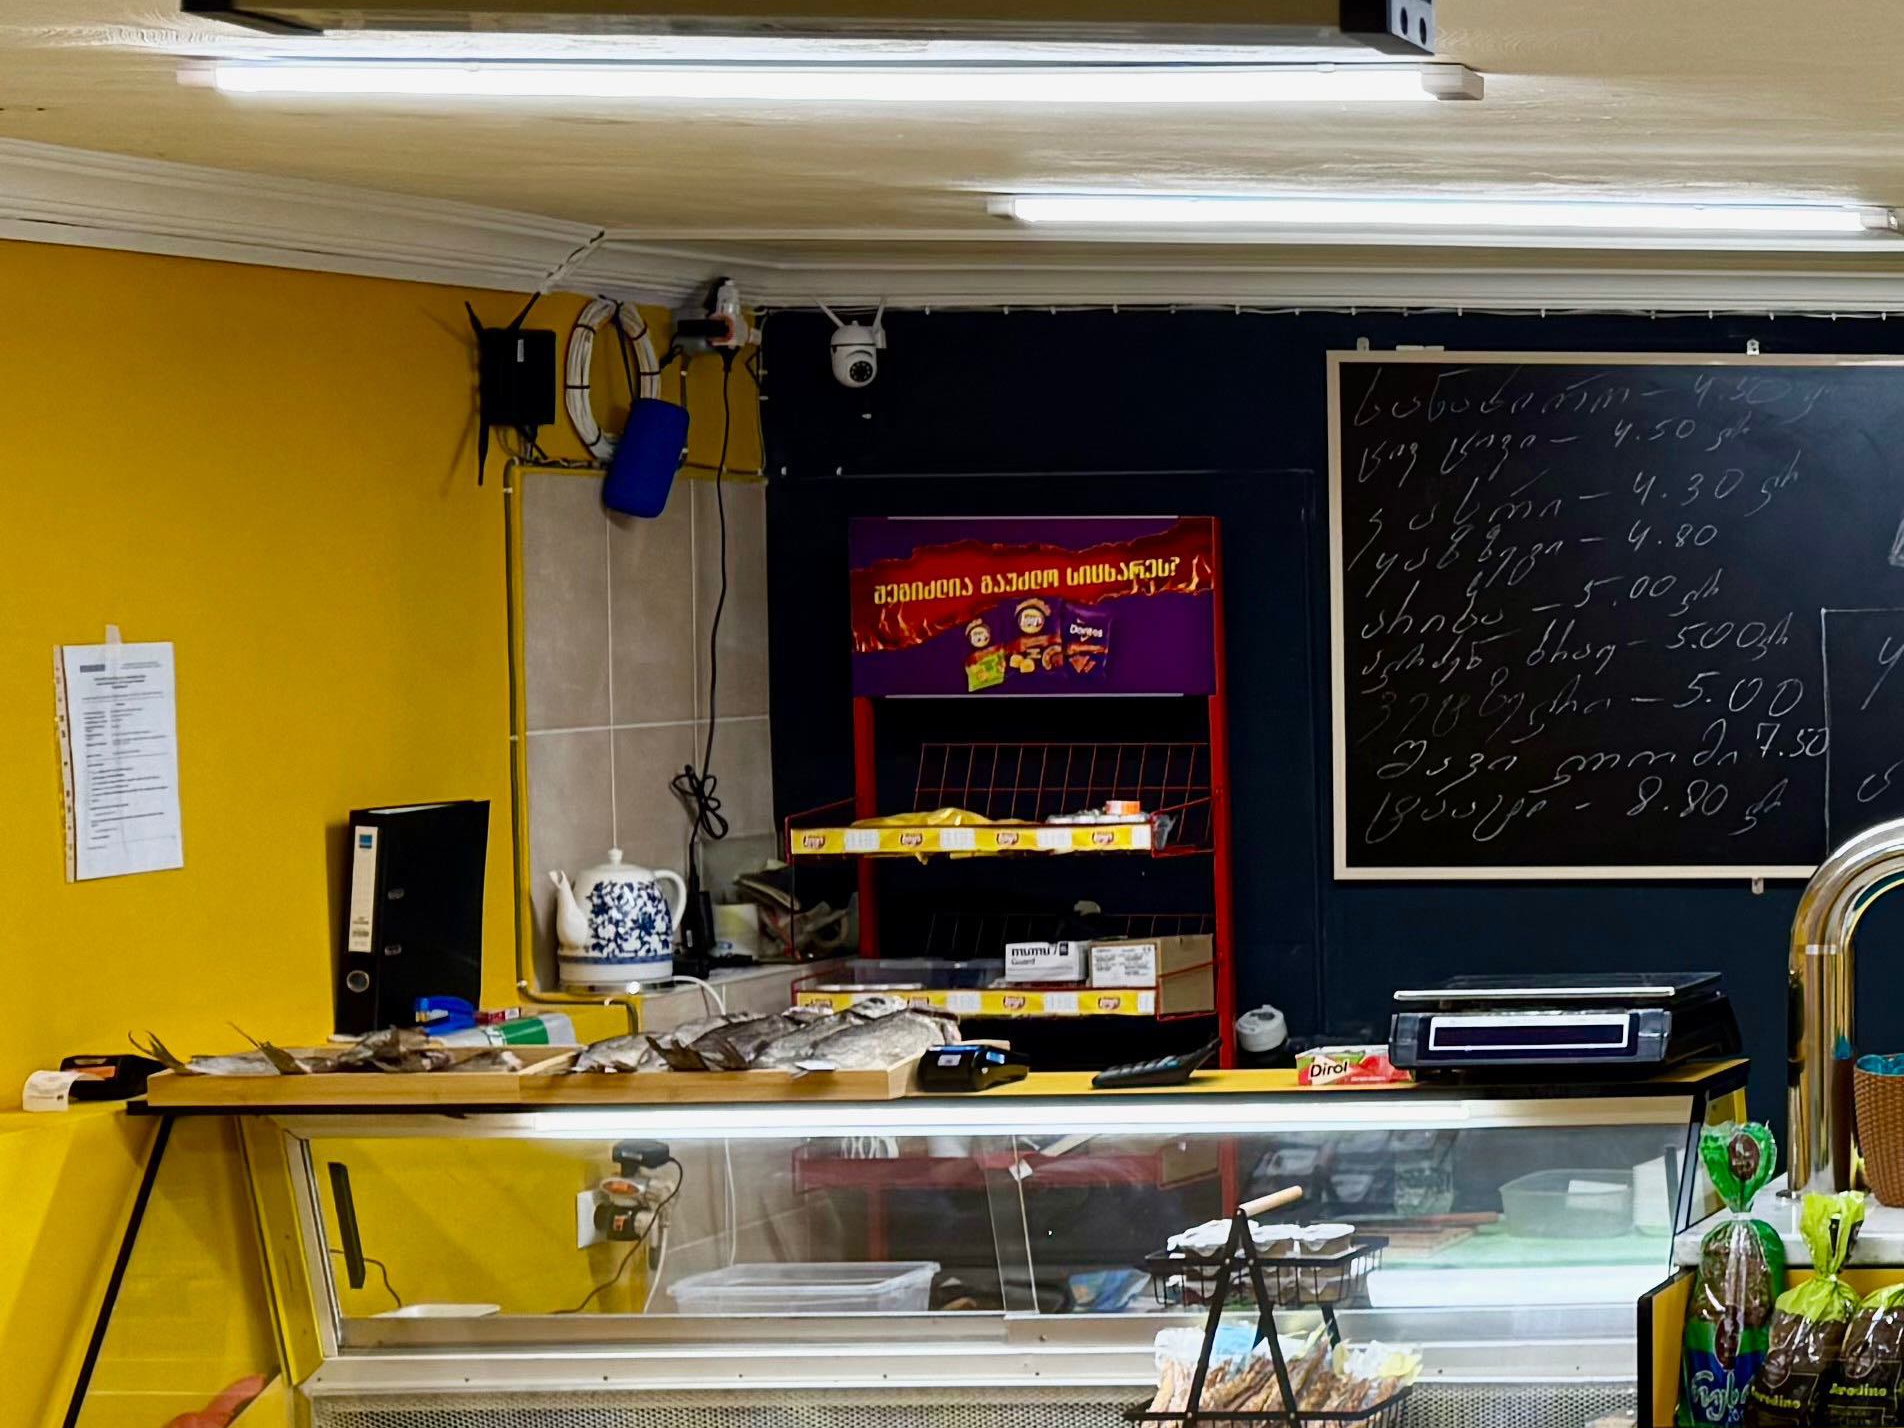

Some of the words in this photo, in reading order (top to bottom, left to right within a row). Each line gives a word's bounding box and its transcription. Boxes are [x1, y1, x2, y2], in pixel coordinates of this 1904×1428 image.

[1614, 418, 1696, 448] 4.50
[1632, 470, 1743, 505] 4.30
[1628, 520, 1719, 549] 4.80
[874, 577, 973, 605] შეგიძლია
[980, 568, 1060, 596] გაუძლო
[1066, 557, 1180, 586] სიცხარეს?
[1575, 575, 1678, 609] 5.00
[1673, 671, 1804, 717] 5.00
[1757, 723, 1830, 758] 7.50
[1628, 776, 1728, 819] 8.80
[1310, 1059, 1348, 1079] Dirol
